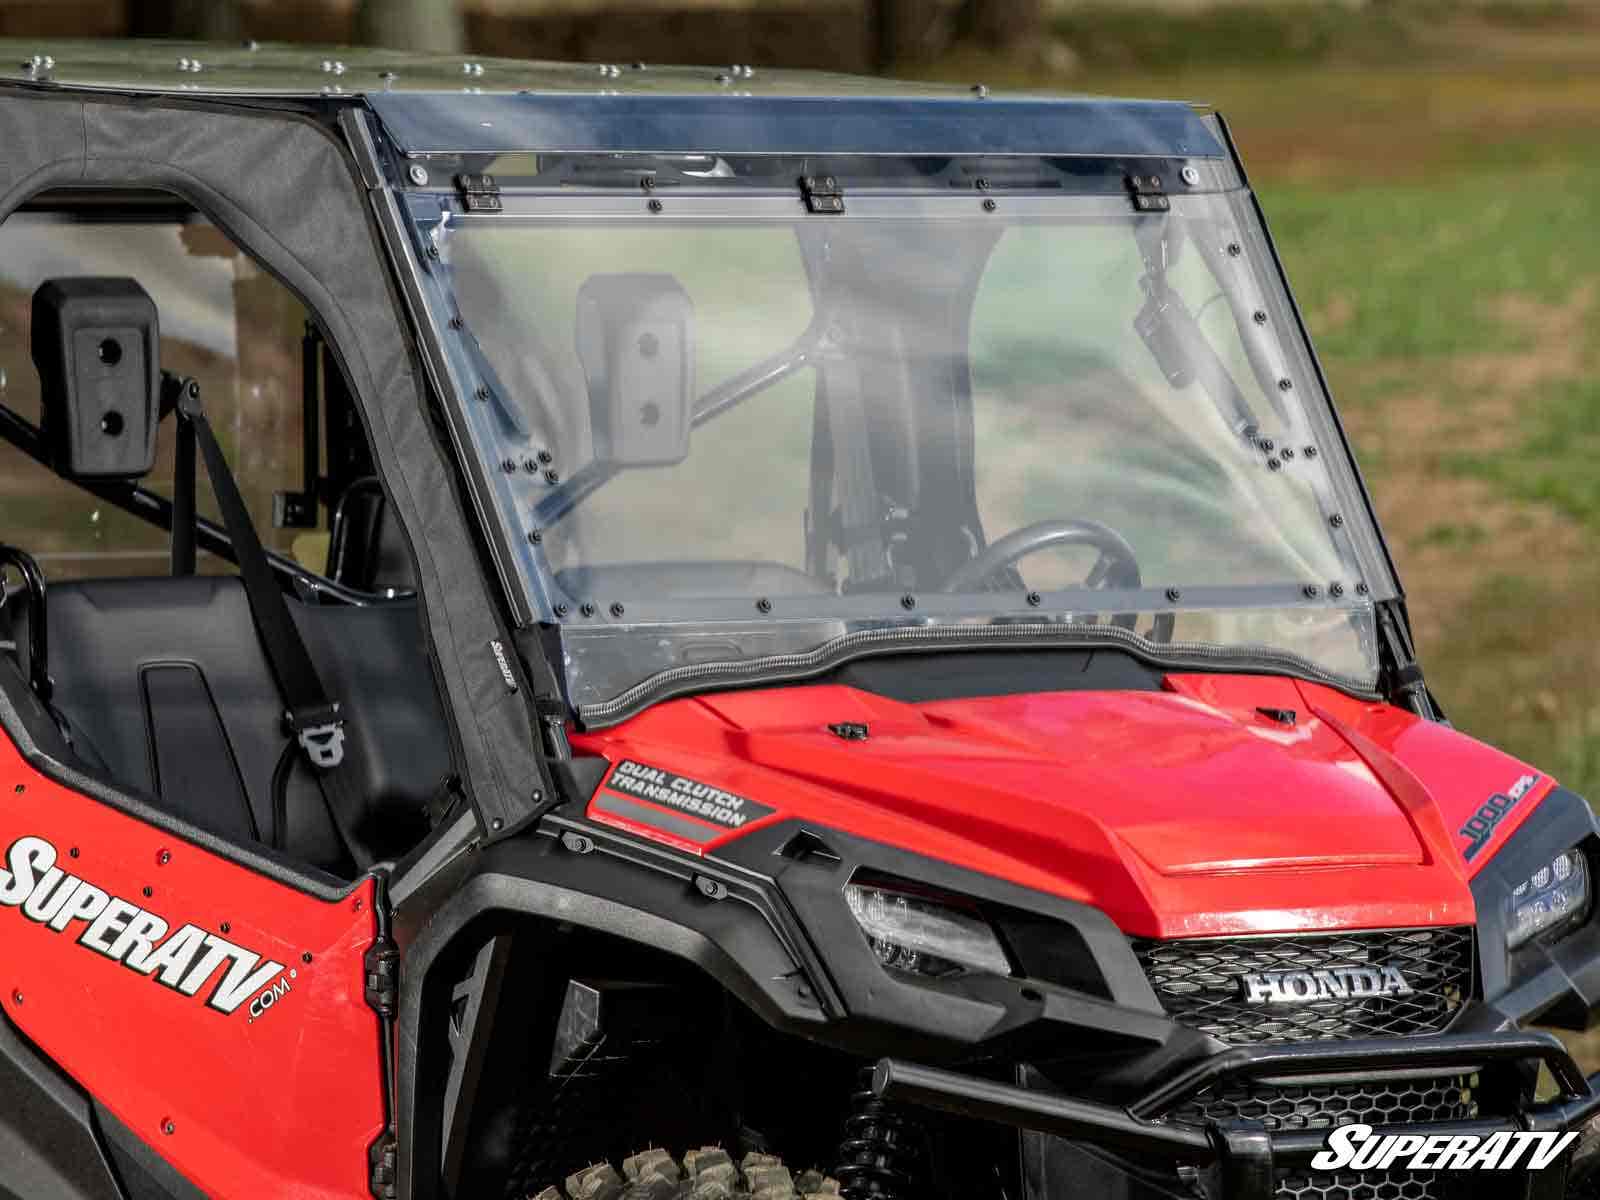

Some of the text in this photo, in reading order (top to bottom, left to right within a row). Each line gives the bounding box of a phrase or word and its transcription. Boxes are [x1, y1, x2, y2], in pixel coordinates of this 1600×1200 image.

[610, 772, 747, 827] TRANSMISSION
[618, 760, 745, 811] DUAL CLUTCH
[1459, 792, 1511, 841] 1000
[0, 835, 287, 1015] SUPERATV
[1242, 966, 1414, 1003] HONDA
